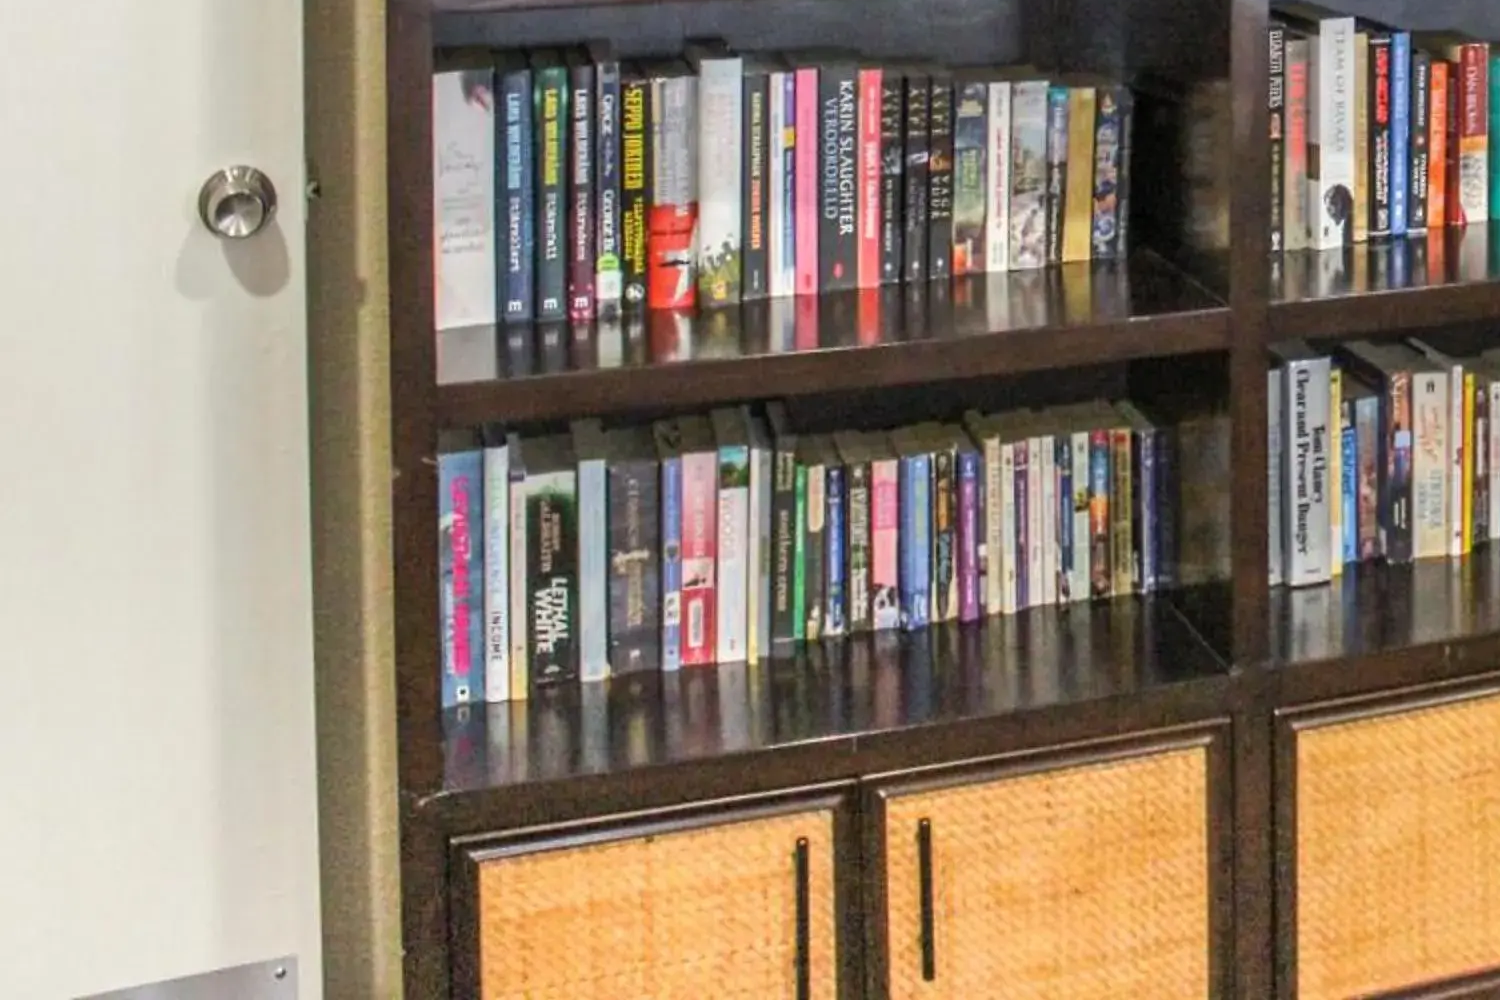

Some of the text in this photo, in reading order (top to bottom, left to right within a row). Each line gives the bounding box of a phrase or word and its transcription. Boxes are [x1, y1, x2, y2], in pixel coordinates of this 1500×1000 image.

[839, 79, 854, 235] KARIN SLAUGHTER
[1296, 368, 1310, 556] Clear and Present Danger
[1311, 424, 1326, 504] Tom Clancy
[490, 610, 502, 662] INCOME
[535, 587, 553, 655] WHITE
[551, 577, 568, 642] LETHAL
